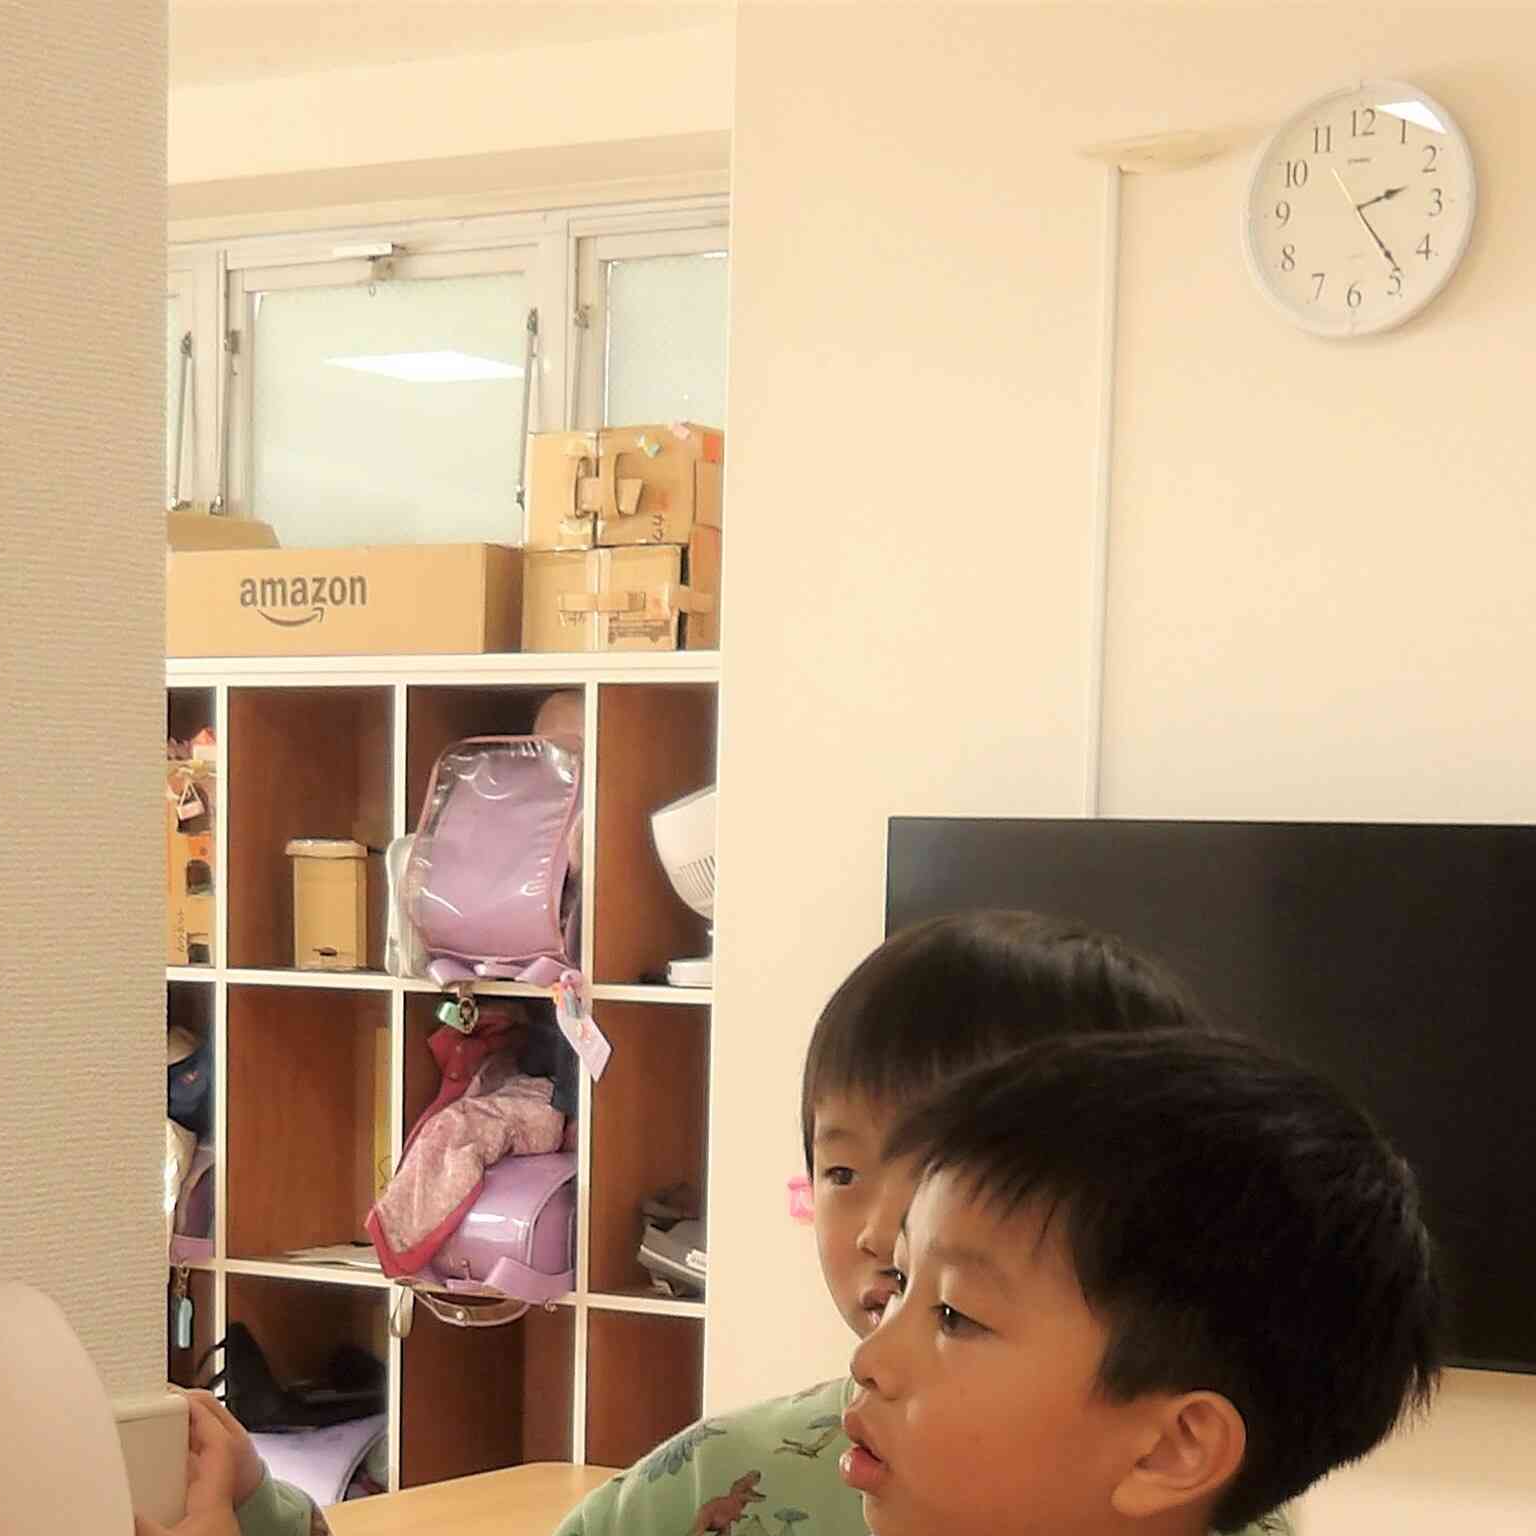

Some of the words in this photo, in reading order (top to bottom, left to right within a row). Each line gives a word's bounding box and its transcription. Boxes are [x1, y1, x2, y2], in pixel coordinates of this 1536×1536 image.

[1351, 108, 1376, 137] 12
[1399, 118, 1407, 145] 1
[1314, 125, 1332, 154] 11
[1422, 145, 1437, 173] 2
[1285, 159, 1308, 188] 10
[1275, 201, 1291, 229] 9
[1428, 188, 1443, 217] 3
[1280, 244, 1296, 272] 8
[1416, 233, 1433, 260] 4
[1311, 272, 1326, 300] 7
[1346, 281, 1362, 309] 6
[1387, 270, 1402, 296] 5
[239, 575, 368, 608] amazon
